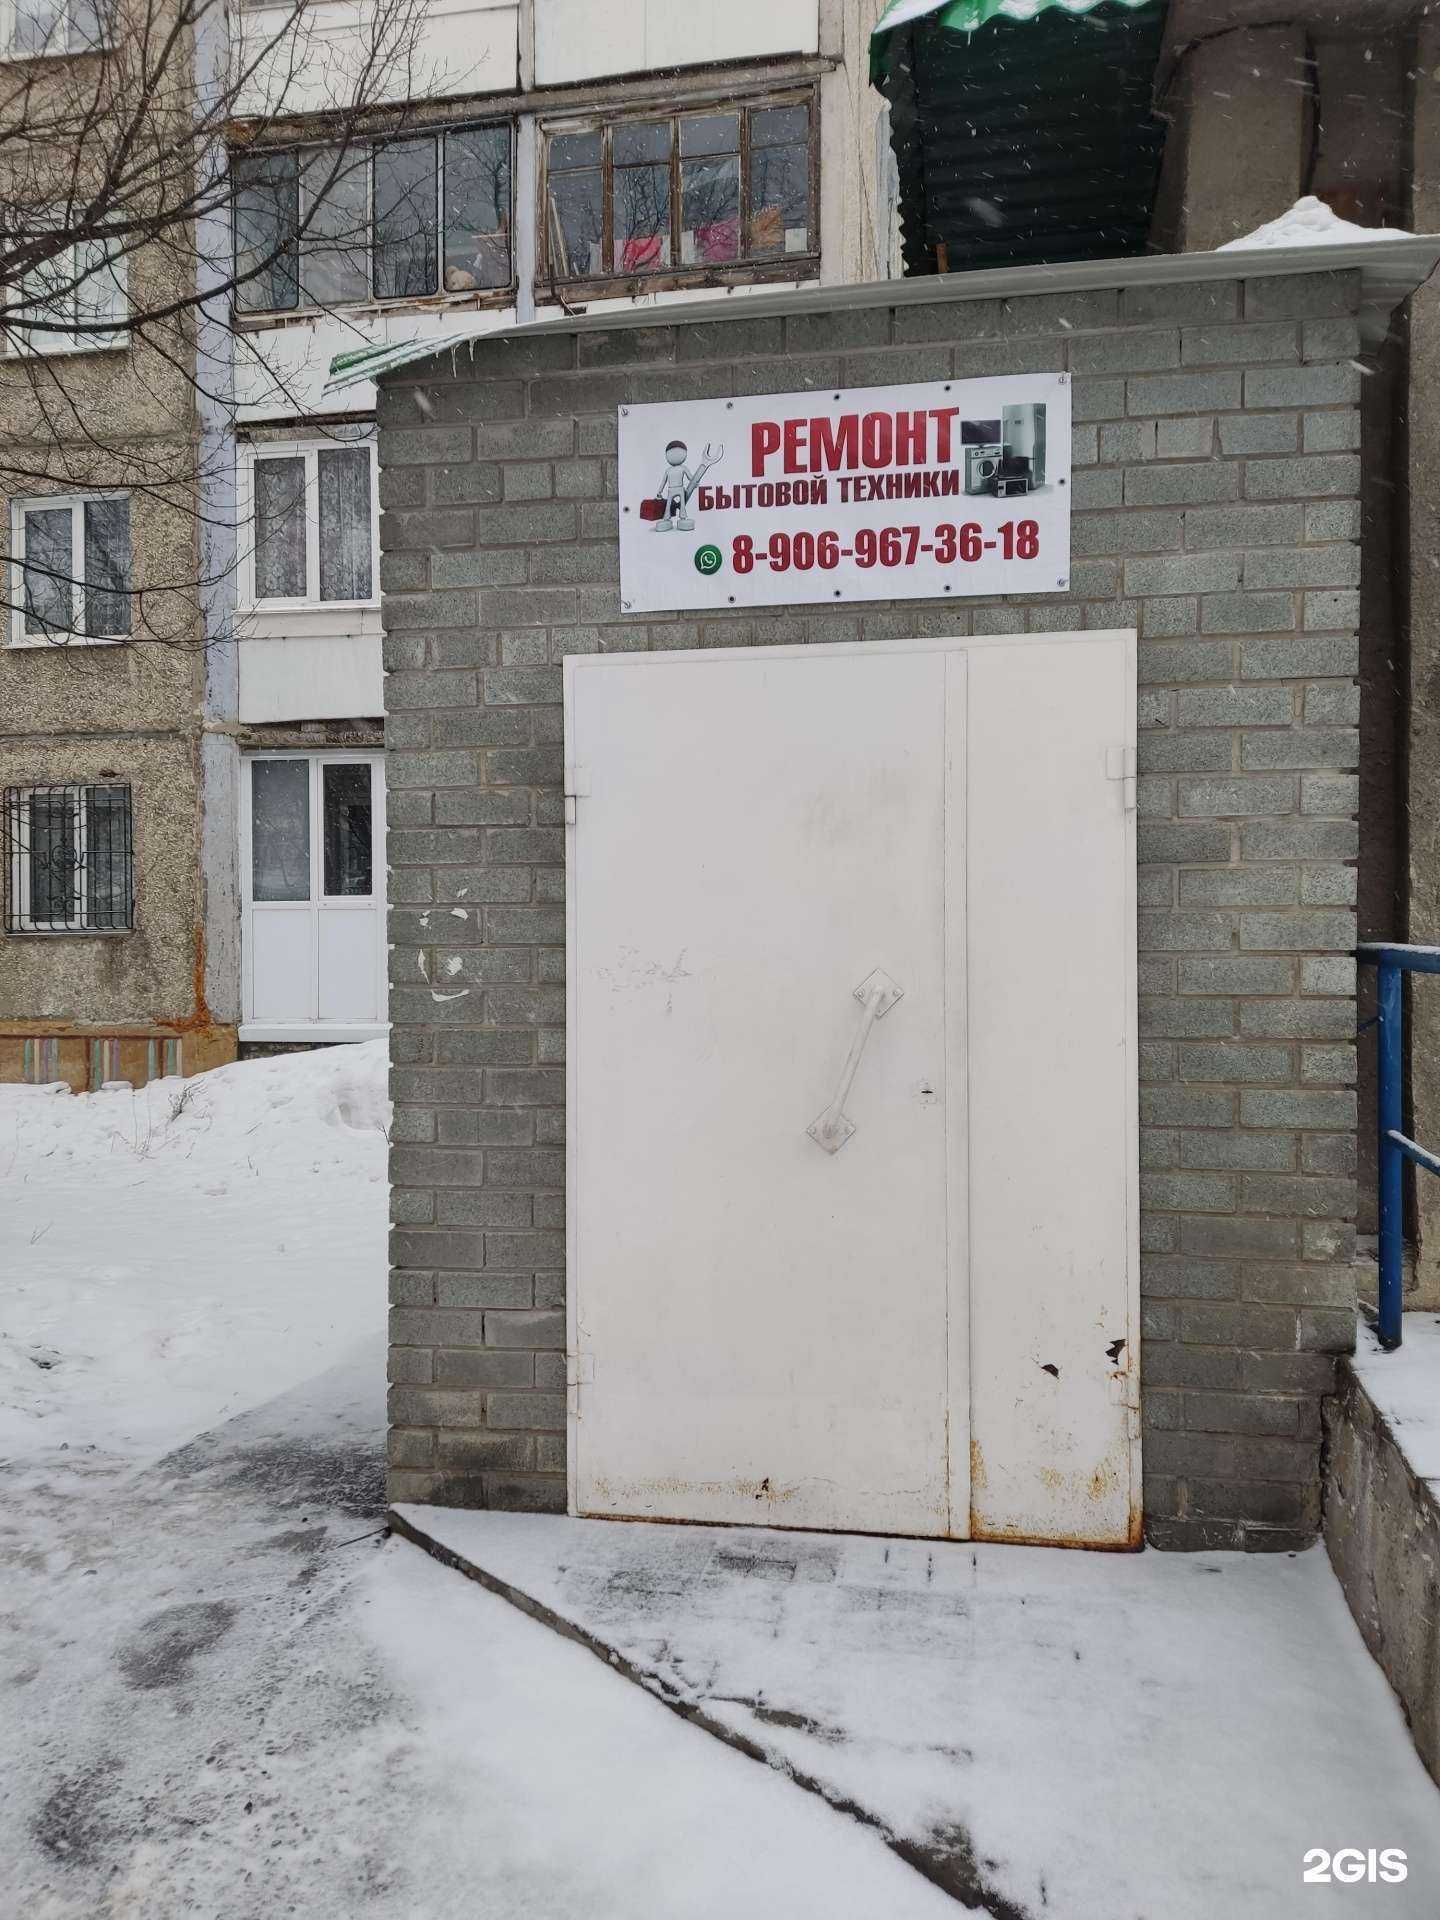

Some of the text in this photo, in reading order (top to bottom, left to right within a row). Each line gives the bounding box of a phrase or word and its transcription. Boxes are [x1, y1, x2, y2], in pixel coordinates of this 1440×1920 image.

[751, 406, 960, 477] РЕМОНТ
[698, 469, 960, 511] БЫТОВОЙ ТЕХНИКИ
[731, 519, 1040, 574] 8-906-967-36-18
